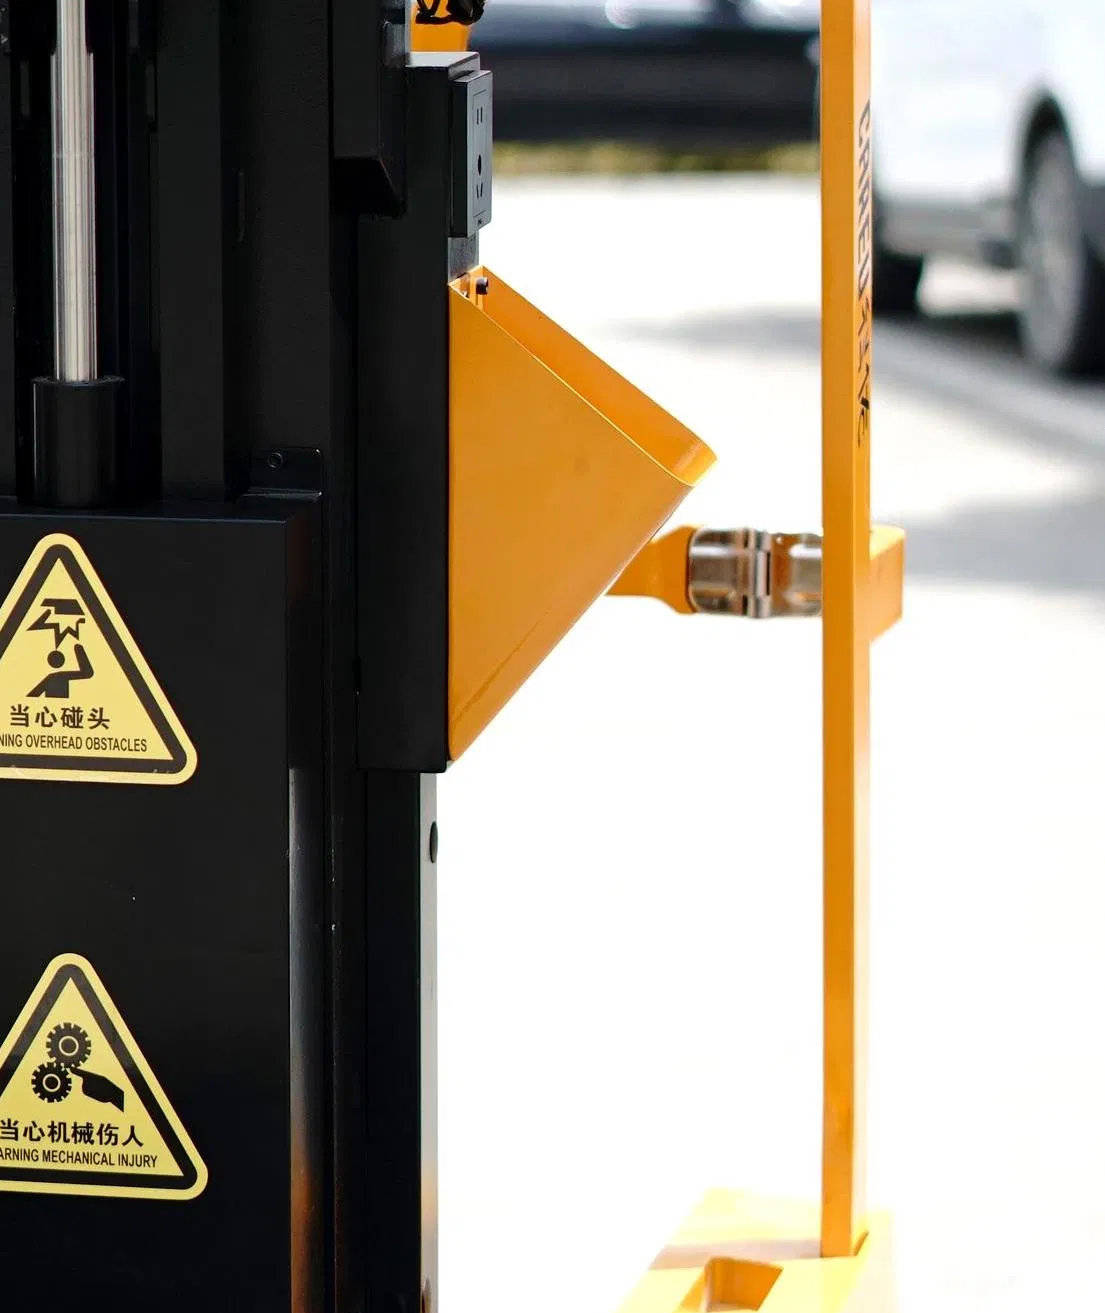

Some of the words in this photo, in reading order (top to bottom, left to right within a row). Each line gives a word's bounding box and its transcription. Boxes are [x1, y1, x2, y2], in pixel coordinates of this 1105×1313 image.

[10, 703, 110, 729] 当心碰头
[25, 735, 82, 750] OVERHEAD
[85, 737, 147, 752] OBSTACLES
[0, 1118, 143, 1147] 当心机械伤人
[42, 1150, 115, 1166] MECHANICAL
[118, 1154, 157, 1168] INJURY
